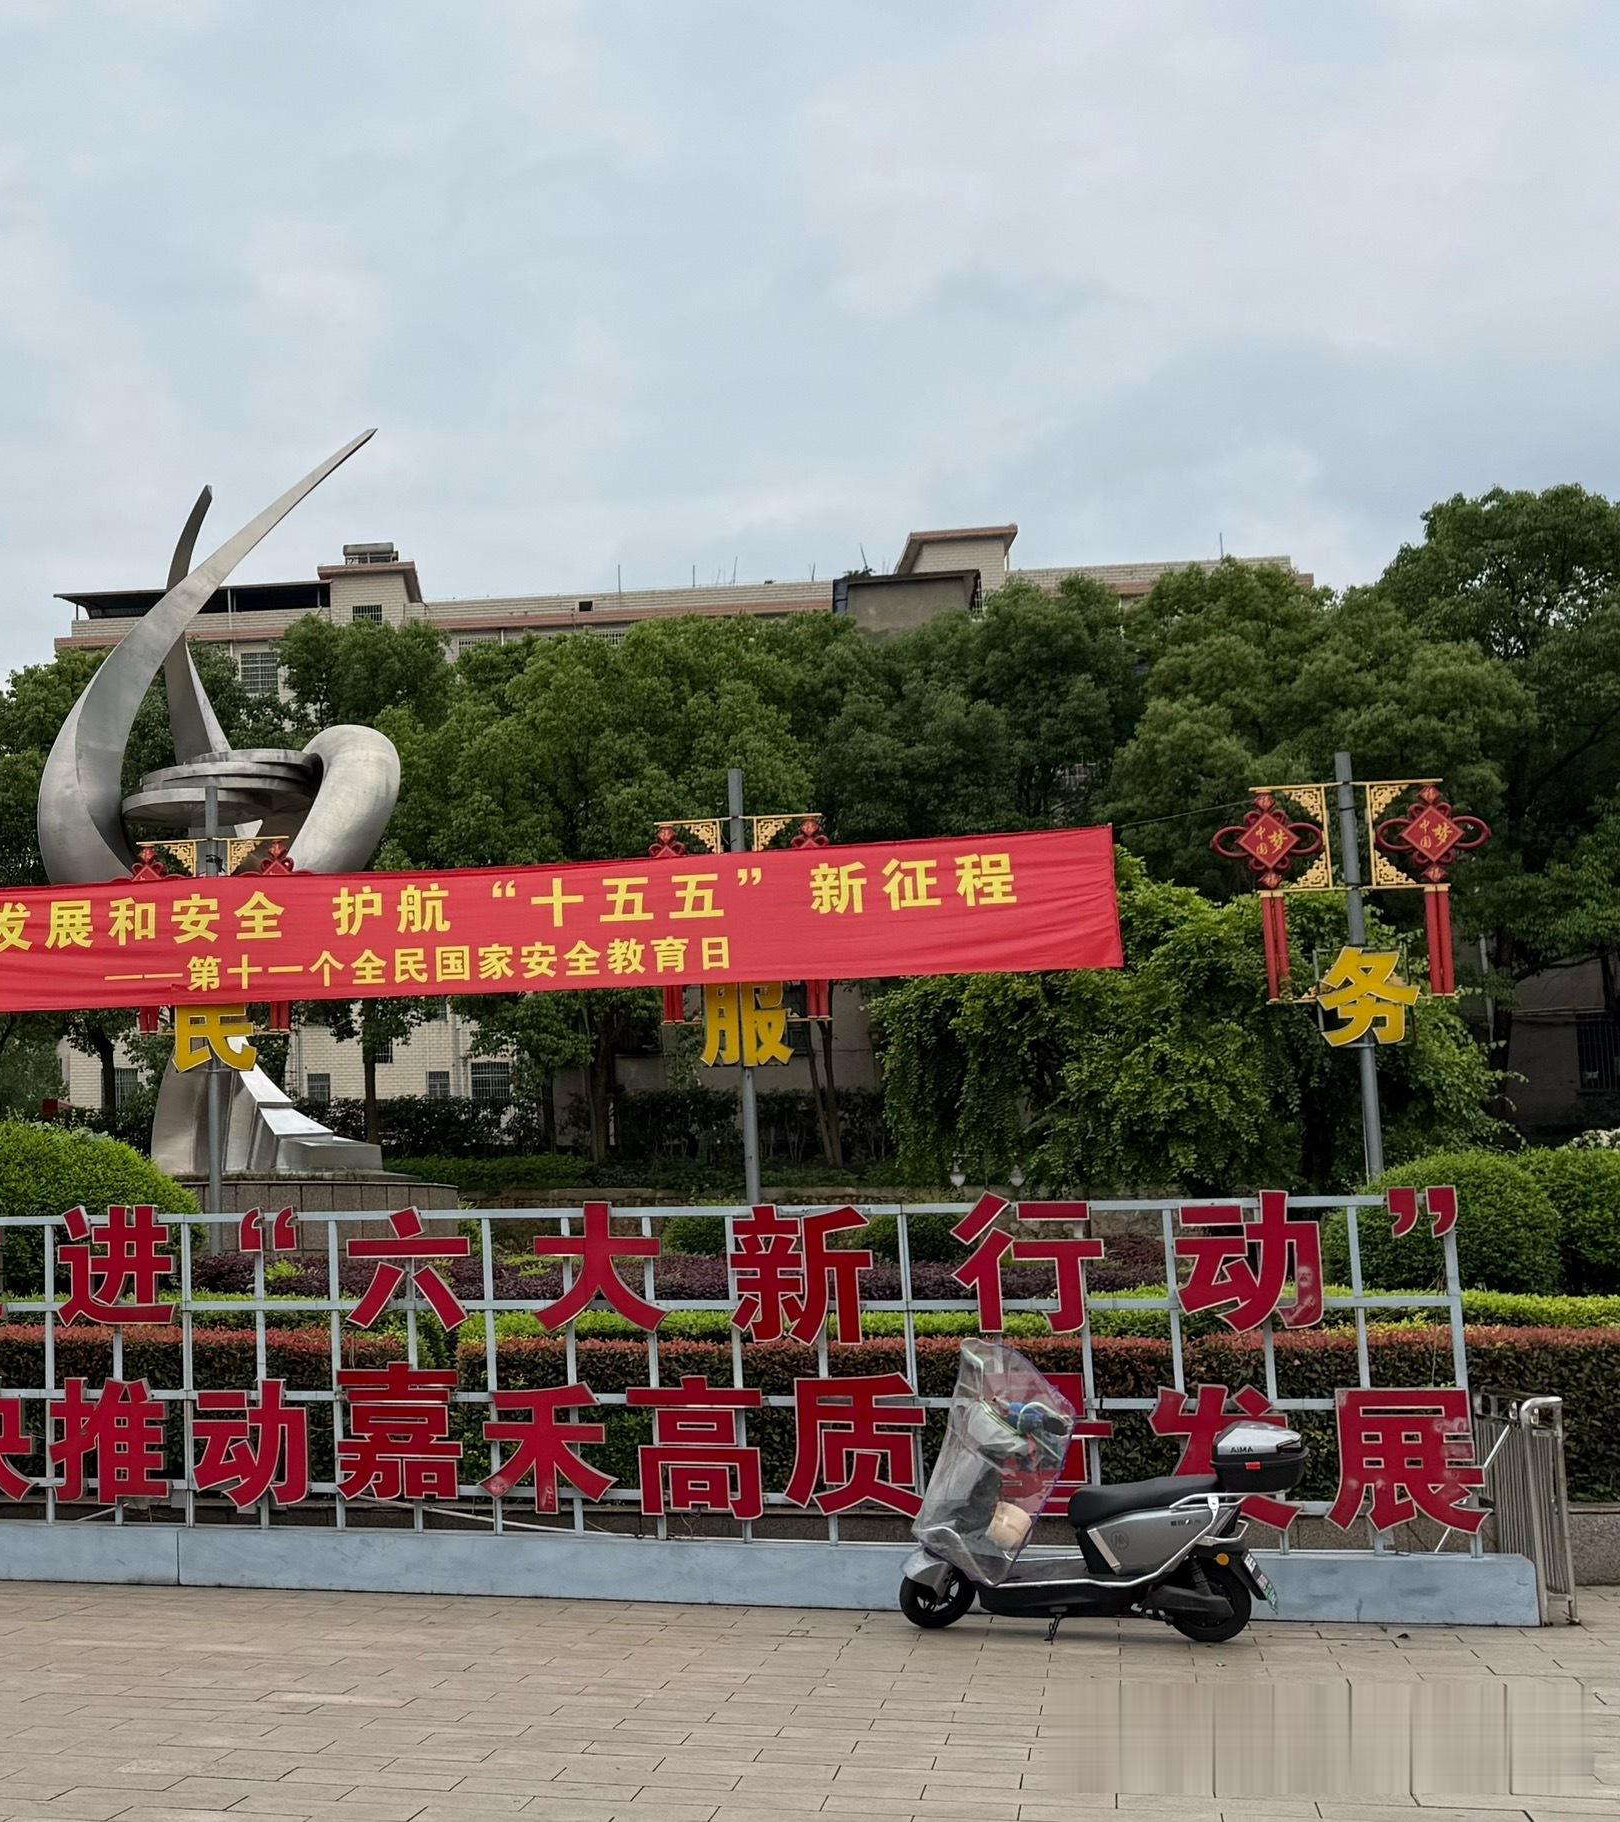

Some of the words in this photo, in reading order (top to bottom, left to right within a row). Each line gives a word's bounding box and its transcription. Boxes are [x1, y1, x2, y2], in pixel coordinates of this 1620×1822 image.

[174, 1005, 257, 1073] 民
[702, 981, 794, 1067] 服
[1316, 945, 1421, 1047] 务
